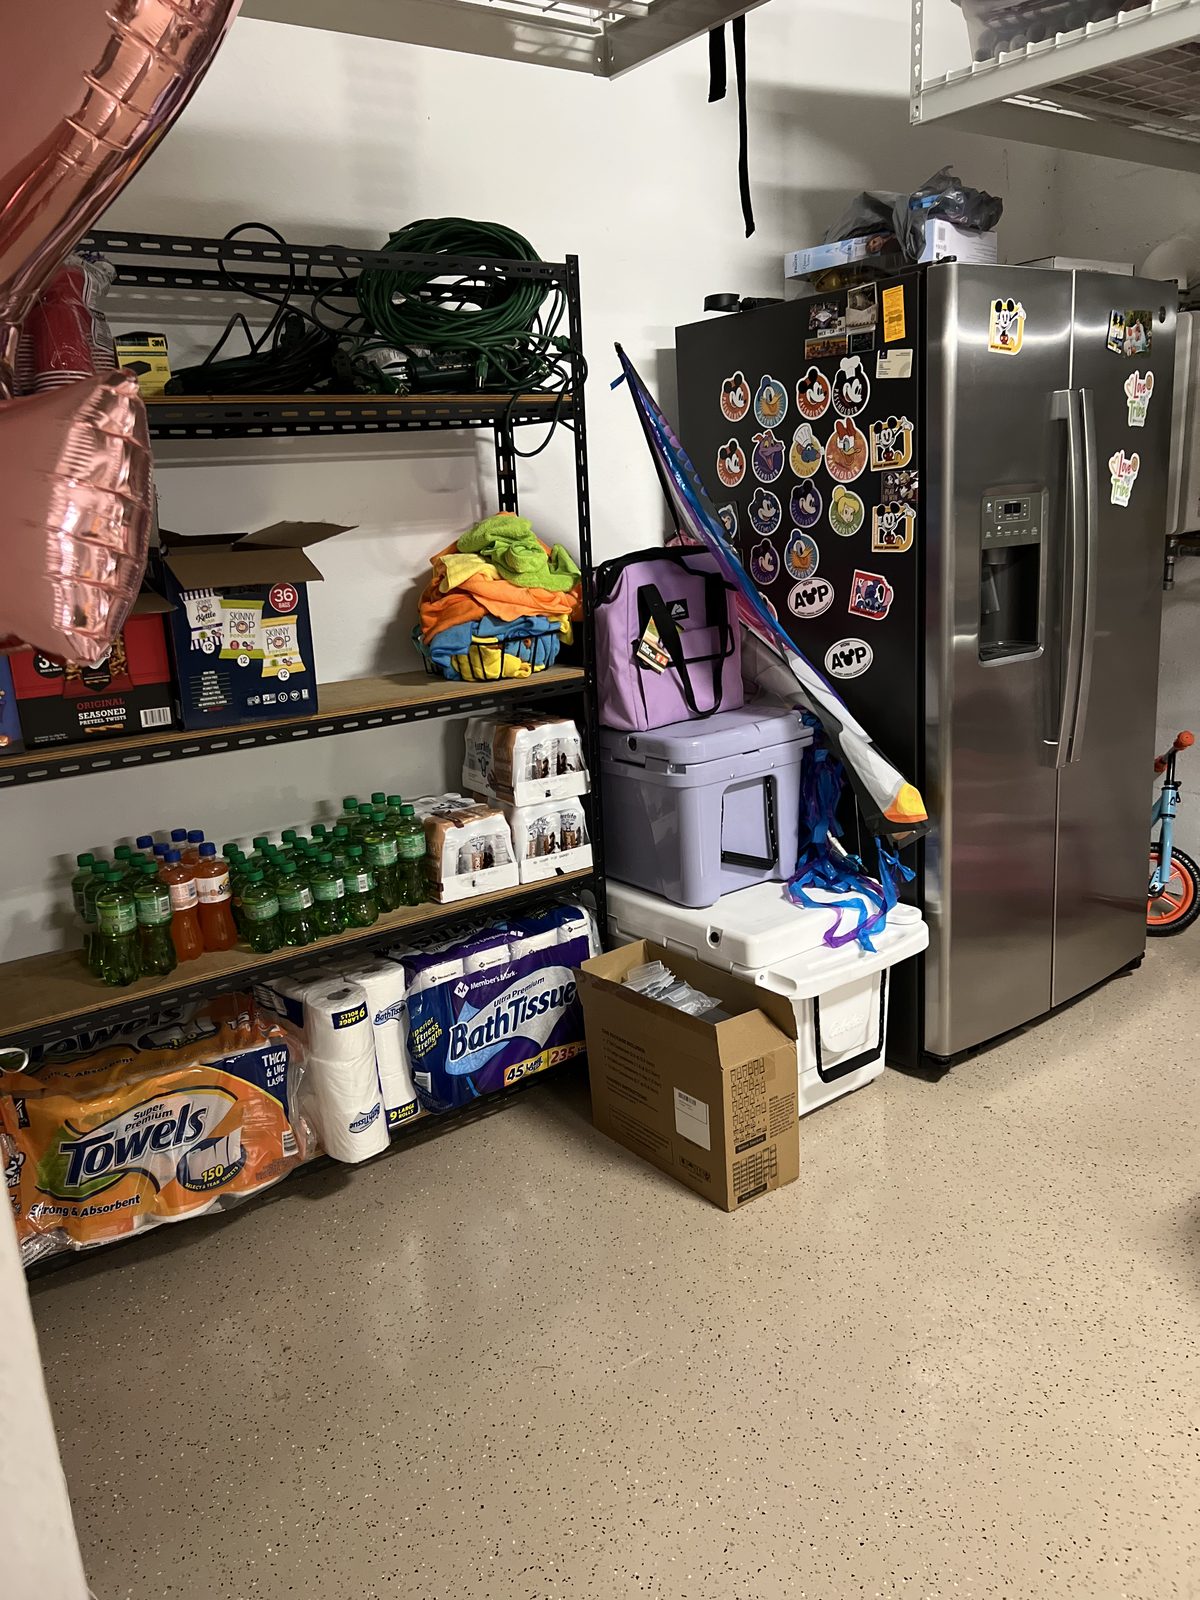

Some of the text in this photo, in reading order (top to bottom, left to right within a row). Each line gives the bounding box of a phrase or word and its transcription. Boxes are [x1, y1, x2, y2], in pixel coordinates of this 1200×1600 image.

[1133, 372, 1146, 399] Love
[799, 398, 825, 417] PASSHOLDER
[834, 388, 859, 416] PASSHOLDER
[754, 461, 779, 481] PASSHOLDER
[827, 454, 860, 480] PASSHOLDER
[1117, 451, 1132, 478] Love
[832, 515, 858, 535] PASSHOLDER
[274, 588, 294, 603] 36
[196, 612, 216, 623] Kettle
[230, 612, 255, 621] SKINNY
[230, 621, 256, 634] POP
[266, 627, 290, 636] SKINNY
[76, 698, 126, 710] ORIGINAL
[78, 708, 126, 720] SEASONED
[79, 714, 127, 726] PRETZEL TWISTS
[470, 971, 517, 990] Member's Mark
[512, 976, 545, 995] Premium
[338, 1007, 366, 1026] 9 LARGE
[340, 1009, 358, 1020] ROLLS
[414, 1022, 440, 1045] ftness
[550, 1047, 576, 1064] 235
[266, 1068, 272, 1078] &
[506, 1064, 524, 1082] 45
[124, 1108, 173, 1132] Premium
[134, 1102, 165, 1121] Super
[390, 1103, 414, 1120] 9 LARGE
[398, 1108, 414, 1120] ROLLS
[60, 1103, 208, 1188] Towels
[202, 1164, 224, 1182] 150
[185, 1182, 202, 1190] SELECT
[207, 1178, 220, 1188] TEAR
[71, 1206, 78, 1216] &
[80, 1194, 140, 1218] Absorbent
